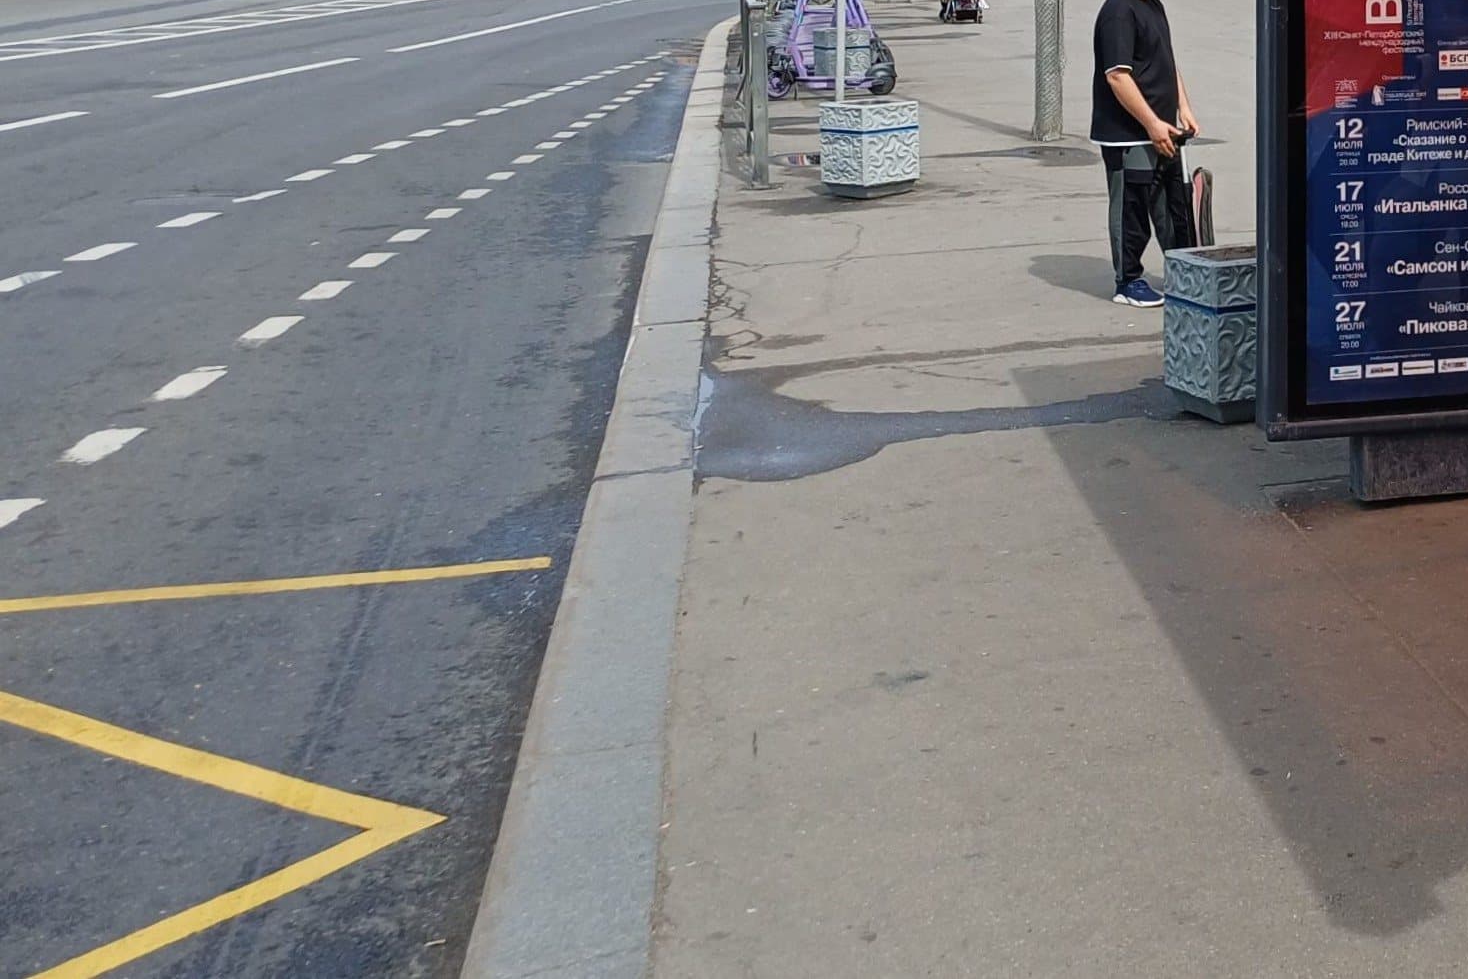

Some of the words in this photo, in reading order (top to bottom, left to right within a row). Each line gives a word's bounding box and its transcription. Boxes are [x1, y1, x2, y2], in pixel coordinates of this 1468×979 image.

[1335, 118, 1364, 139] 12
[1392, 133, 1457, 147] «Сказание
[1458, 135, 1467, 144] о
[1367, 150, 1405, 164] граде
[1406, 148, 1453, 162] Китеже
[1454, 149, 1463, 159] и
[1336, 181, 1364, 202] 17
[1374, 197, 1468, 214] «Итальянка
[1334, 241, 1361, 262] 21
[1386, 259, 1458, 276] «Самсон
[1335, 301, 1367, 323] 27
